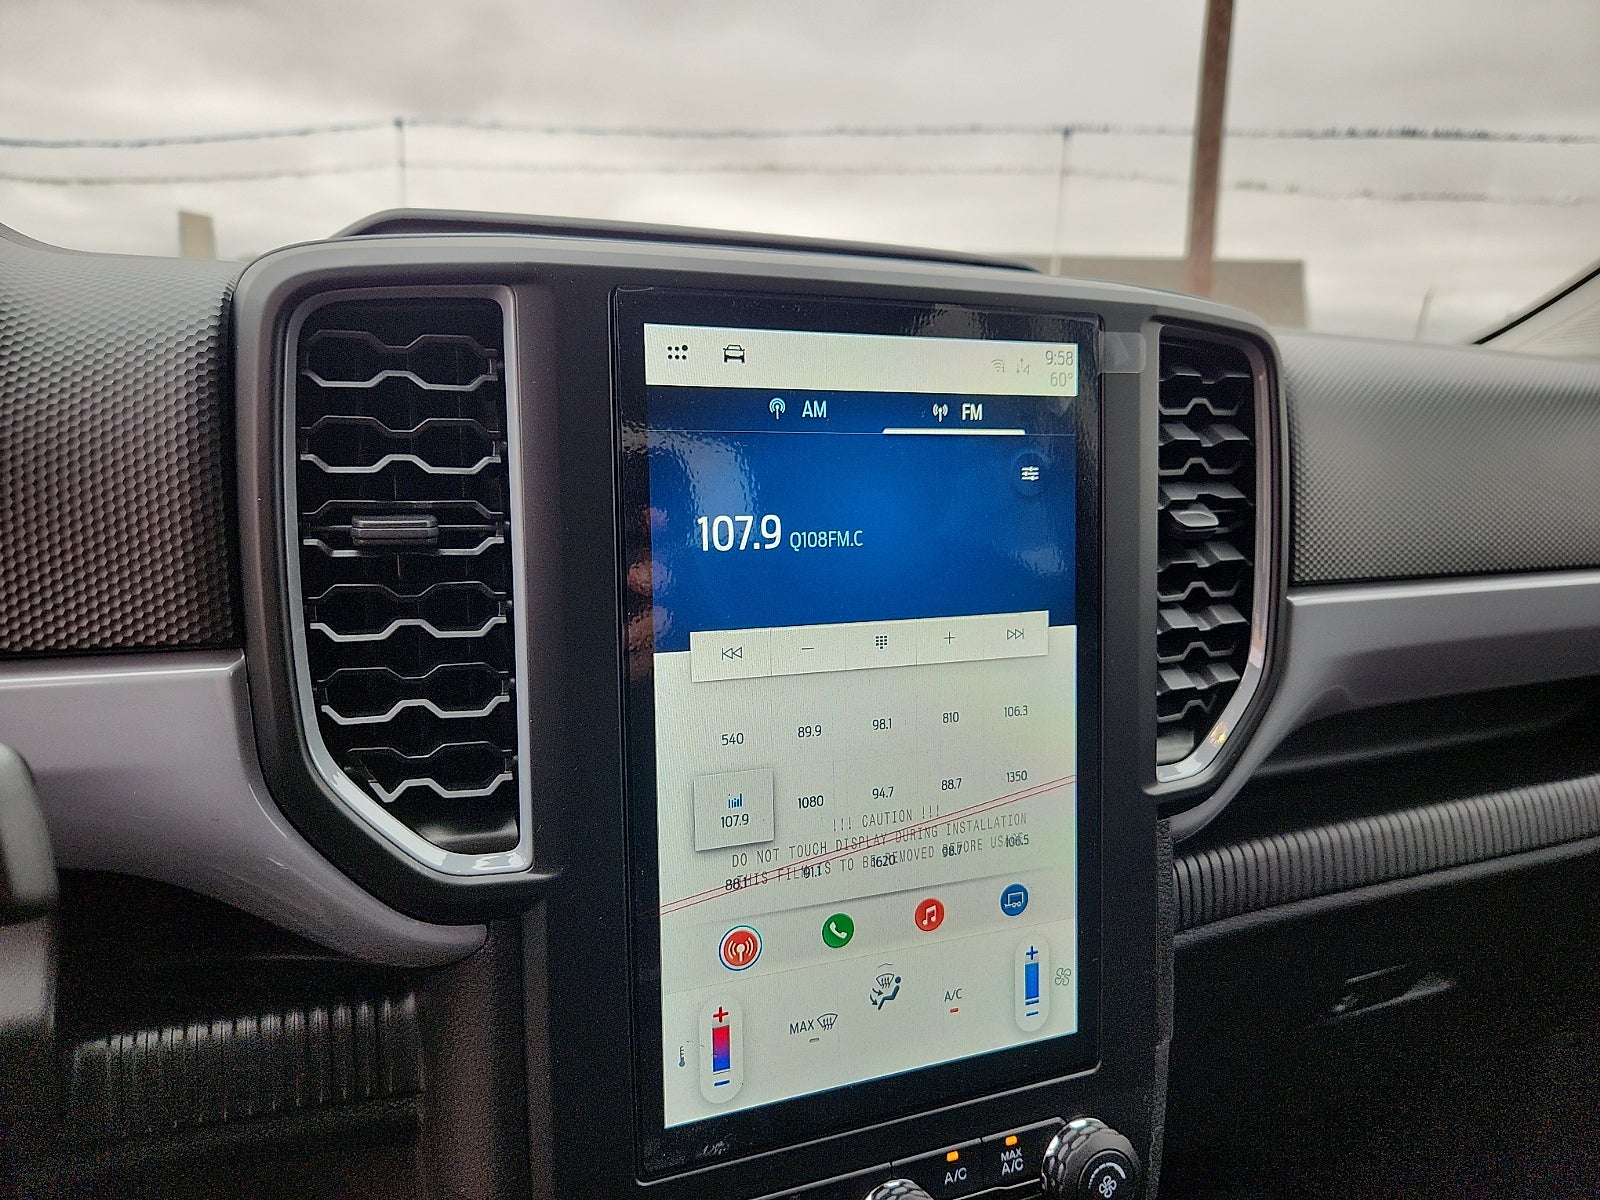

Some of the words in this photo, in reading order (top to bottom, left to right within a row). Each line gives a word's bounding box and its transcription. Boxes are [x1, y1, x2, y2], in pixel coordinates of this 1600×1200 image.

[1045, 350, 1074, 366] 9:58
[1050, 372, 1073, 387] 60°
[801, 401, 828, 419] AM
[961, 403, 984, 422] FM
[697, 513, 782, 552] 107.9
[789, 530, 863, 552] Q108FM.C
[942, 711, 960, 724] 810
[1003, 705, 1028, 718] 106.3
[797, 724, 822, 738] 89.9
[872, 717, 893, 731] 98.1
[720, 732, 745, 747] 540
[1006, 769, 1028, 783] 1350
[941, 778, 962, 791] 88.7
[872, 786, 894, 800] 94.7
[797, 795, 824, 809] 1080
[720, 813, 749, 829] 107.9
[862, 808, 913, 828] CAUTION
[732, 852, 748, 868] DO
[756, 848, 780, 864] NOT
[788, 841, 828, 859] TOUCH
[835, 832, 887, 852] DISPLAY
[895, 825, 938, 843] DURING
[946, 812, 1028, 836] INSTALLATION
[1005, 834, 1030, 848] 106.5
[840, 857, 854, 872] TO
[725, 876, 747, 891] 88.1
[944, 987, 963, 1002] A/C
[789, 1019, 815, 1036] MAX
[1000, 1148, 1023, 1163] MAX
[1001, 1157, 1024, 1175] A/C
[944, 1166, 968, 1184] A/C
